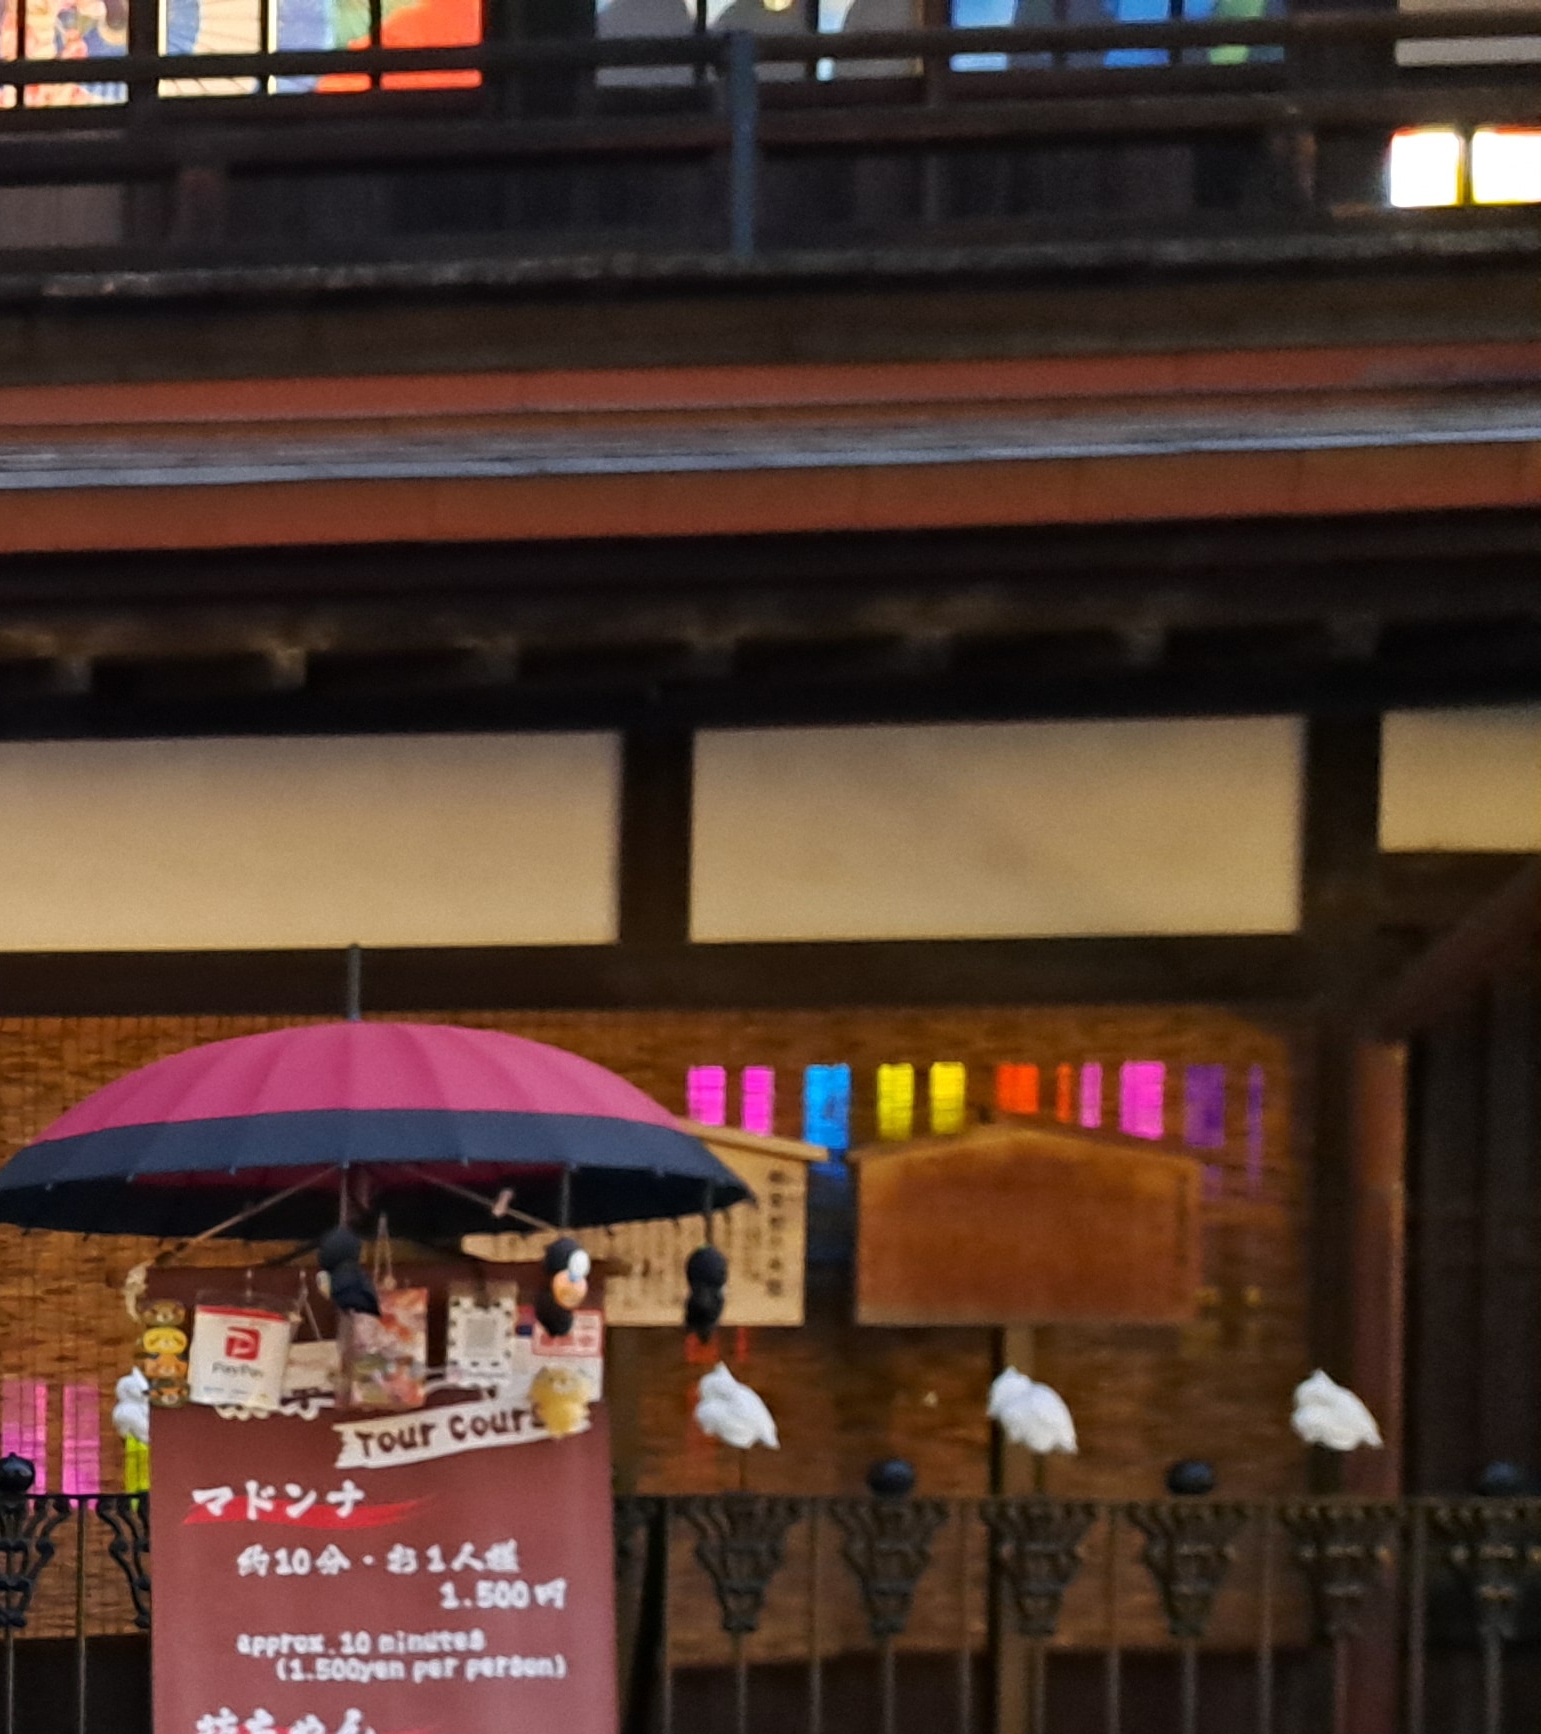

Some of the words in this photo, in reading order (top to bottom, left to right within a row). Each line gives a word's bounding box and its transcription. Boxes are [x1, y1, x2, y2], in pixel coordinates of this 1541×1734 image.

[354, 1422, 435, 1458] Tour
[191, 1478, 366, 1521] マドンナ
[377, 1627, 486, 1655] minutes
[412, 1656, 460, 1683] per
